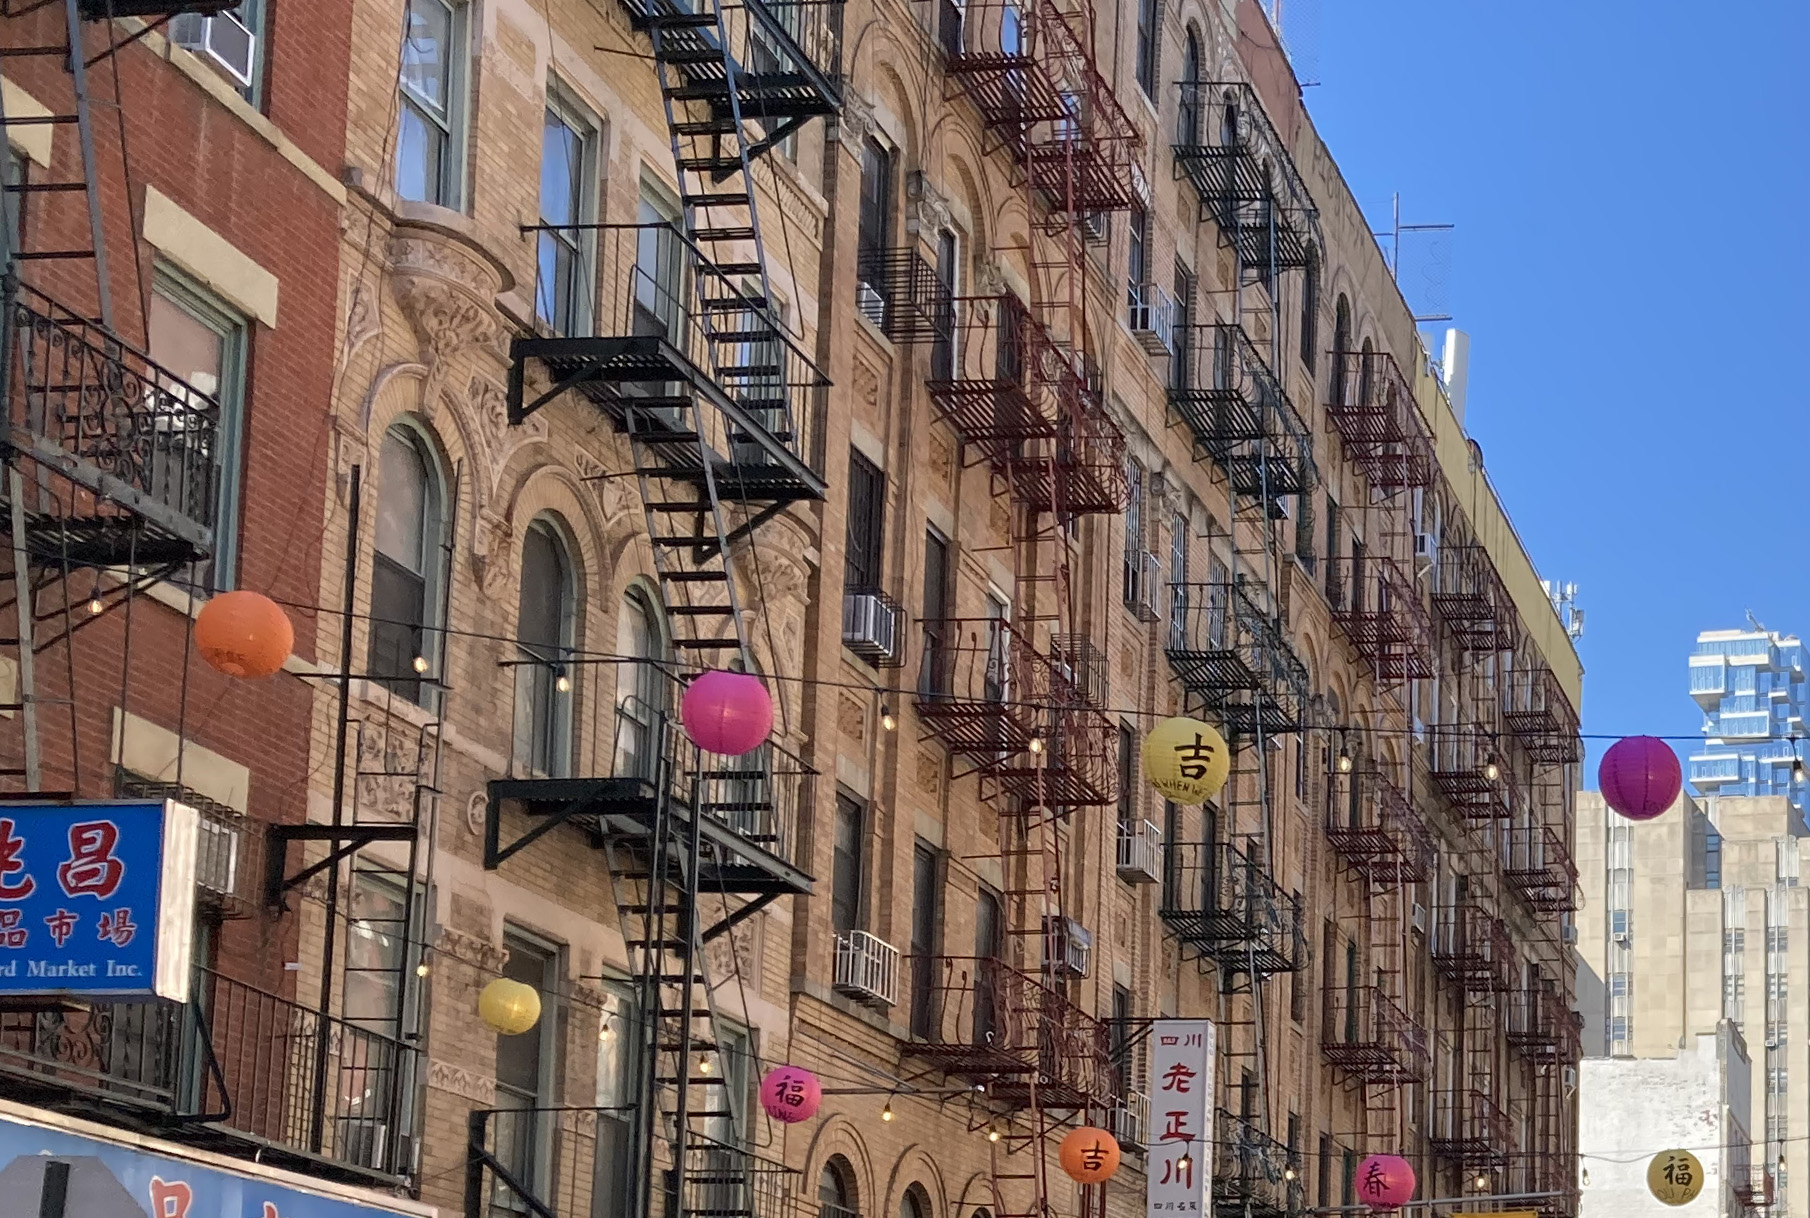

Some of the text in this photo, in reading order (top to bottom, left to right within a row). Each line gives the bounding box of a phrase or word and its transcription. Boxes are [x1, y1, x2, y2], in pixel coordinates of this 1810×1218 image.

[1173, 731, 1215, 780] 吉
[27, 959, 97, 977] Market
[106, 959, 143, 977] Inc.
[1080, 1139, 1110, 1172] 吉
[1663, 1155, 1693, 1187] 福
